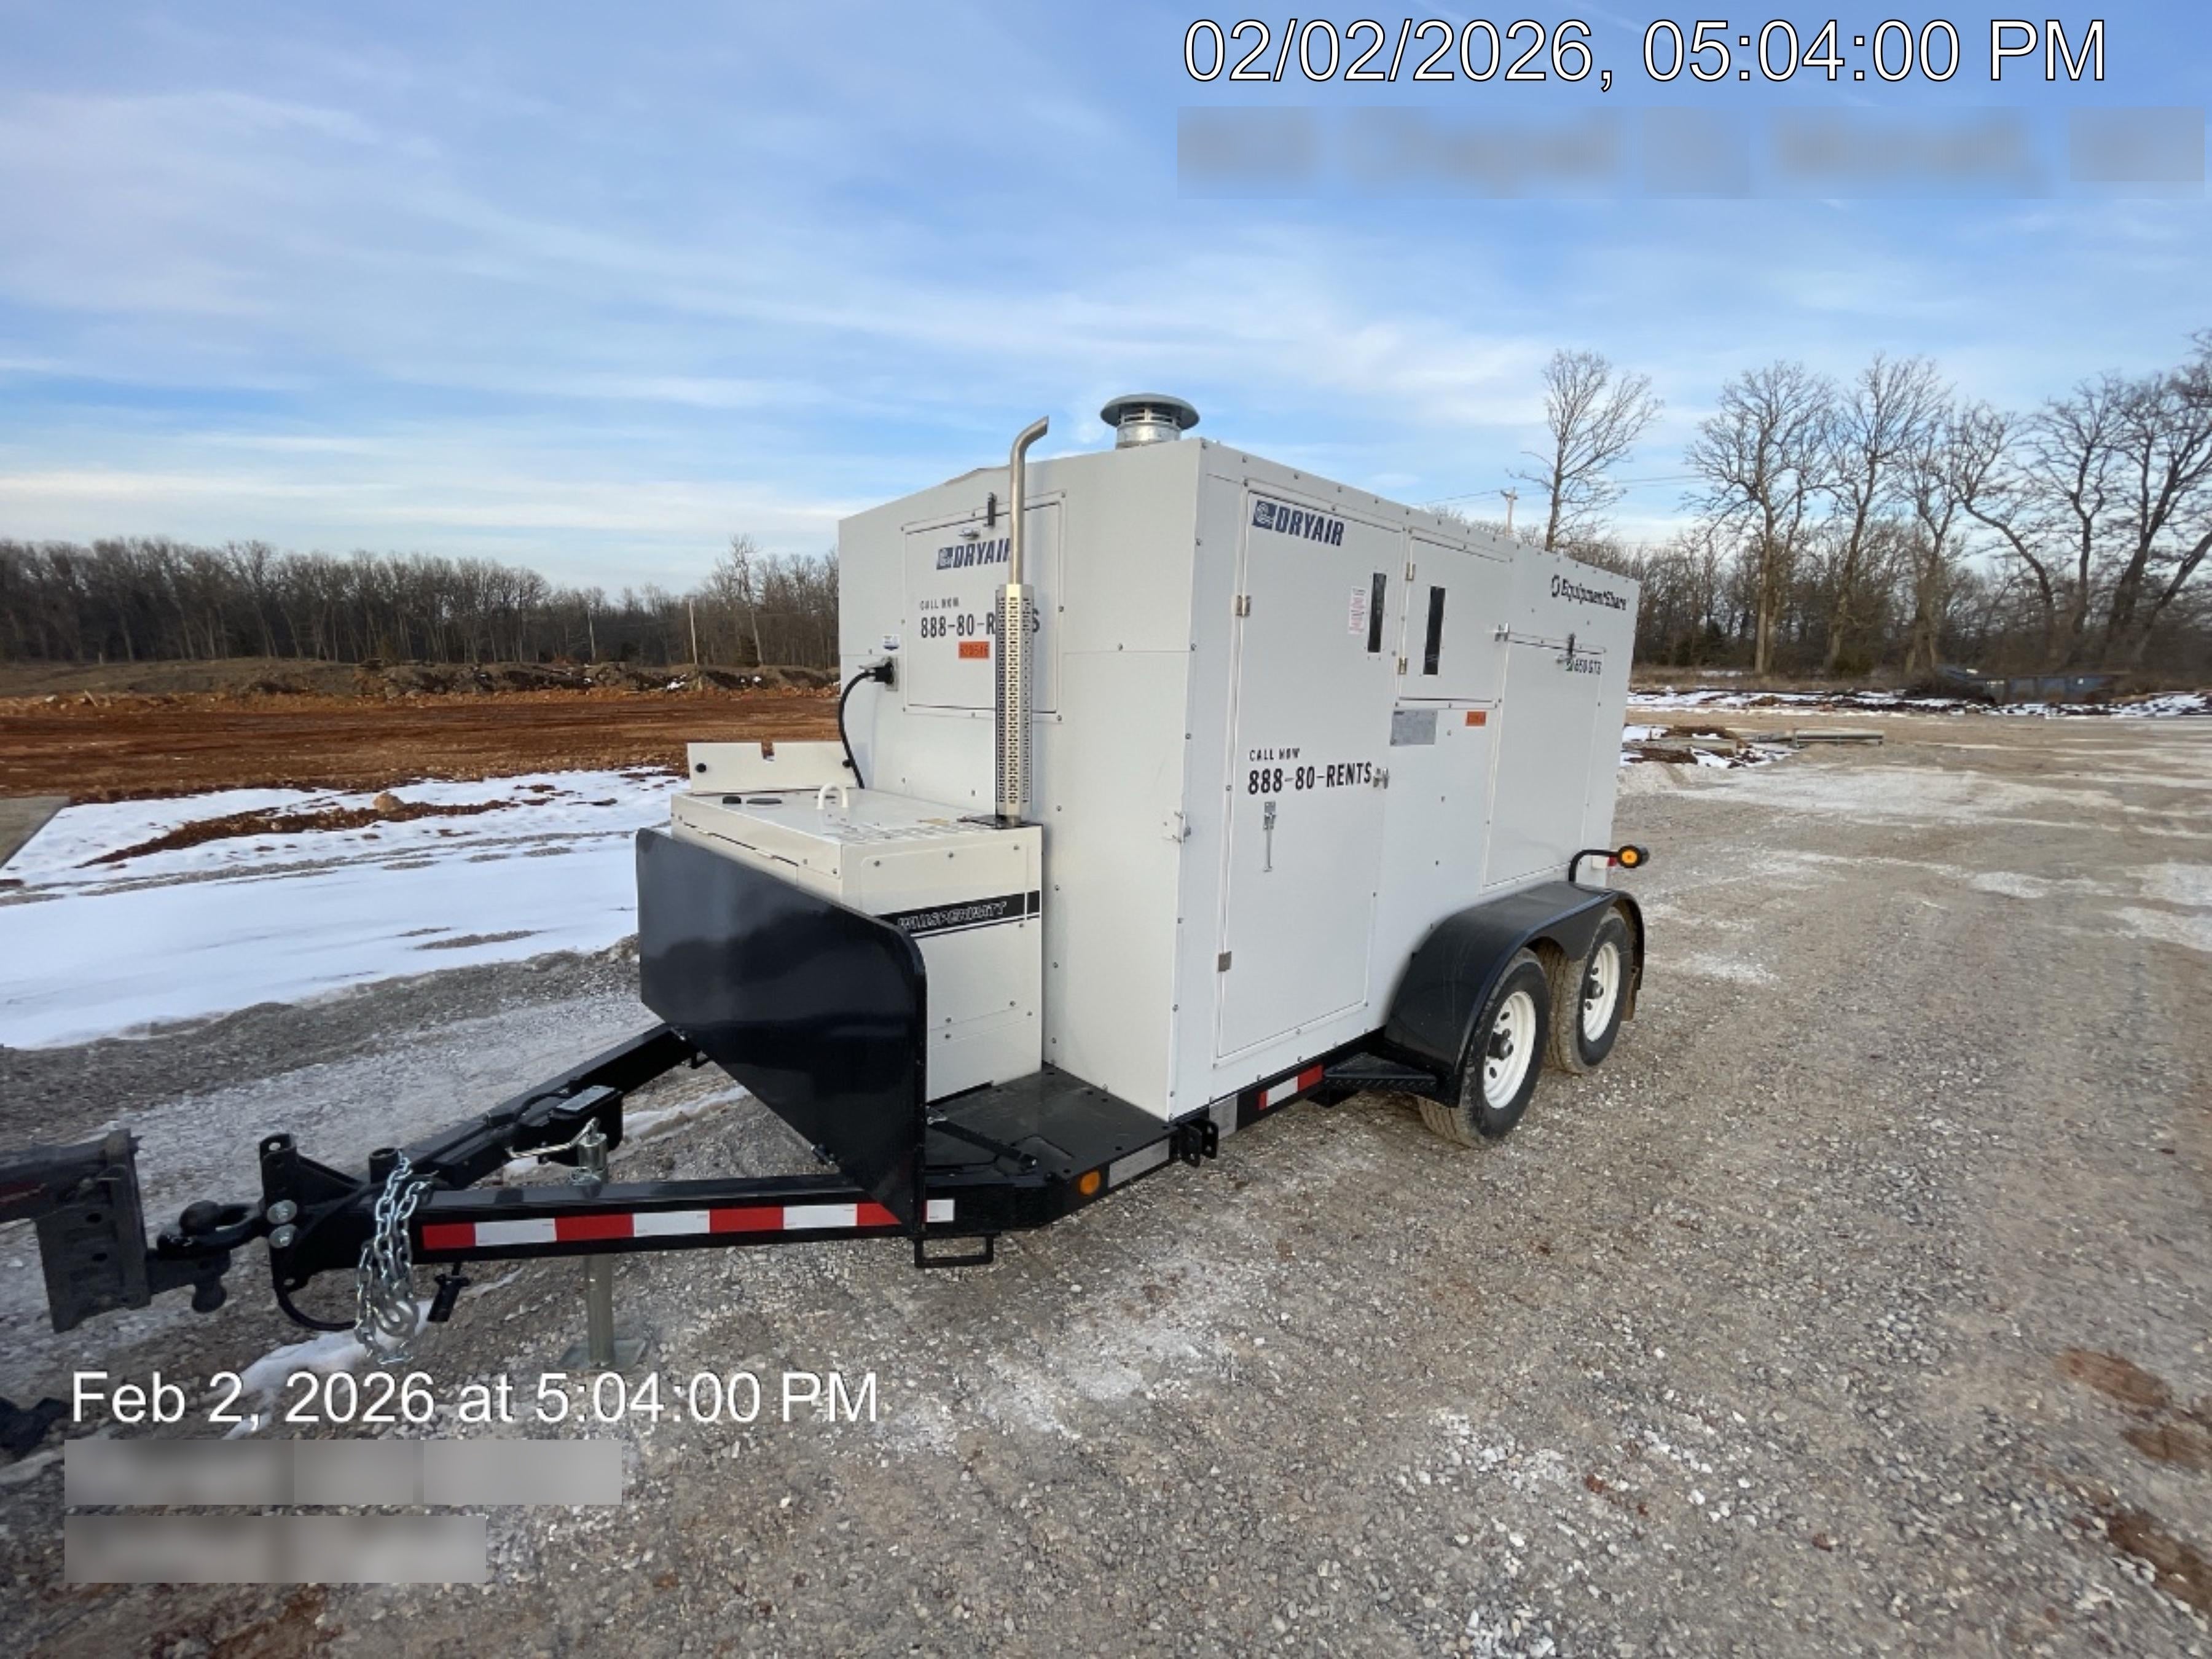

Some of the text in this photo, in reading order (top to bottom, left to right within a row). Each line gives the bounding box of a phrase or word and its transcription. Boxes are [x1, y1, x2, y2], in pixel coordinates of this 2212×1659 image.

[1274, 506, 1345, 546] DRYAIR
[1249, 748, 1300, 762] CALL NOW
[1248, 761, 1372, 795] 888-80-RENTS
